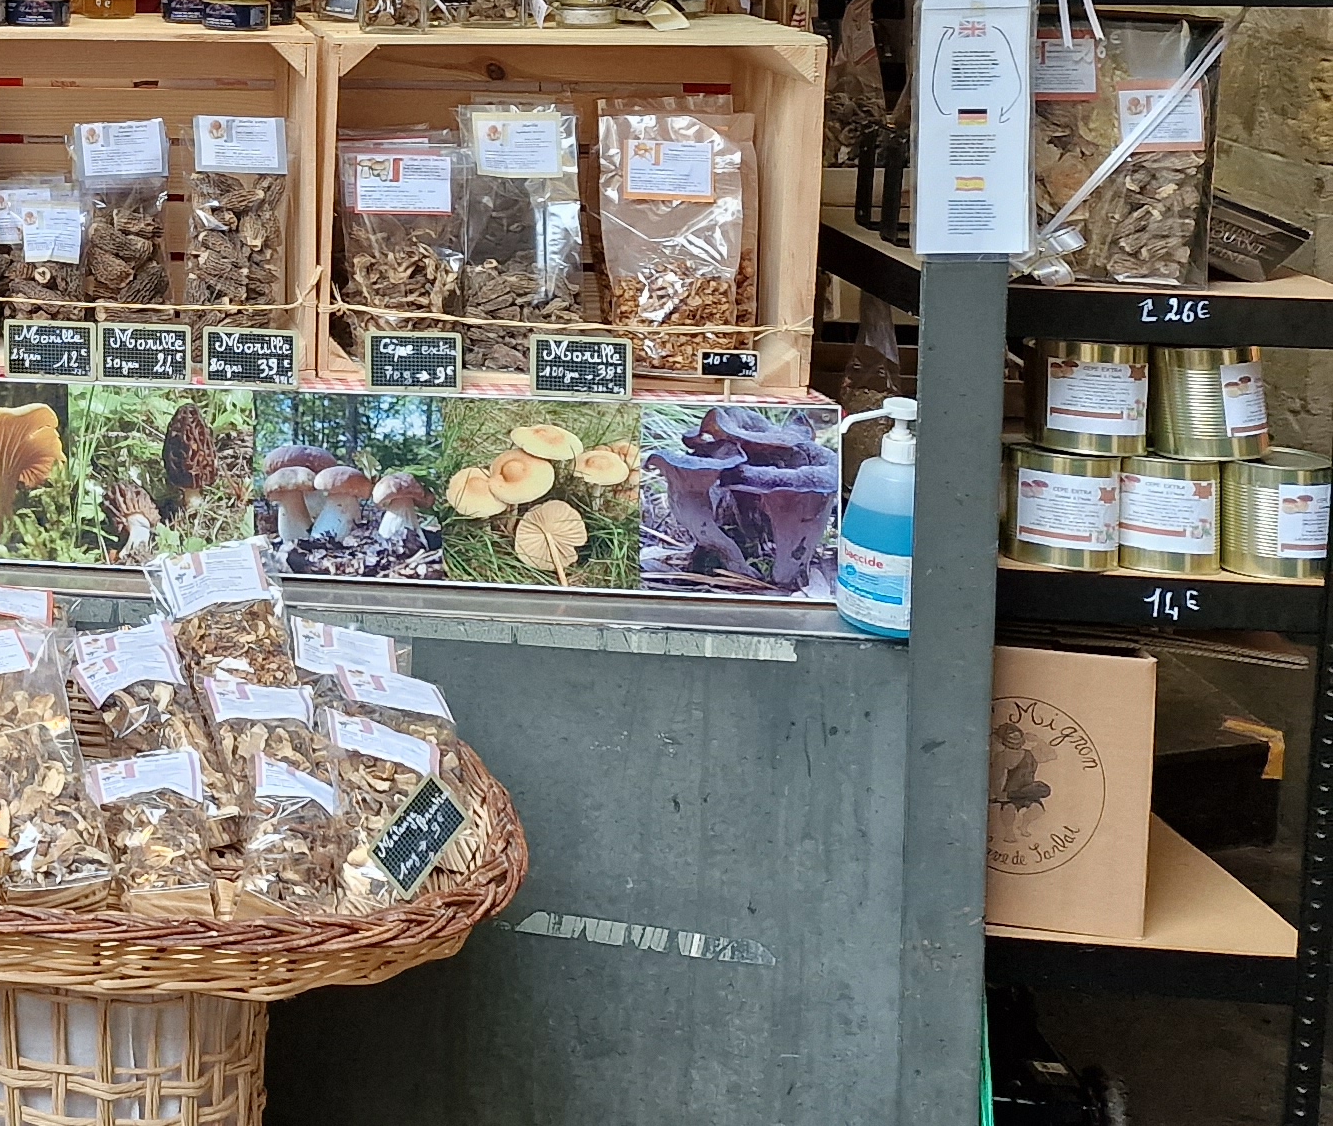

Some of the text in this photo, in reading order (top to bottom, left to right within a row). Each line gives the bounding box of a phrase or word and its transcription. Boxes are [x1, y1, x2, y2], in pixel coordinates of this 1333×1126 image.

[15, 325, 84, 344] Morille
[110, 328, 185, 350] Morille
[215, 332, 292, 354] Morille
[543, 339, 623, 364] Morille
[844, 543, 884, 569] baccide
[1009, 702, 1099, 770] Mignon
[1011, 825, 1081, 865] de Sarlat
